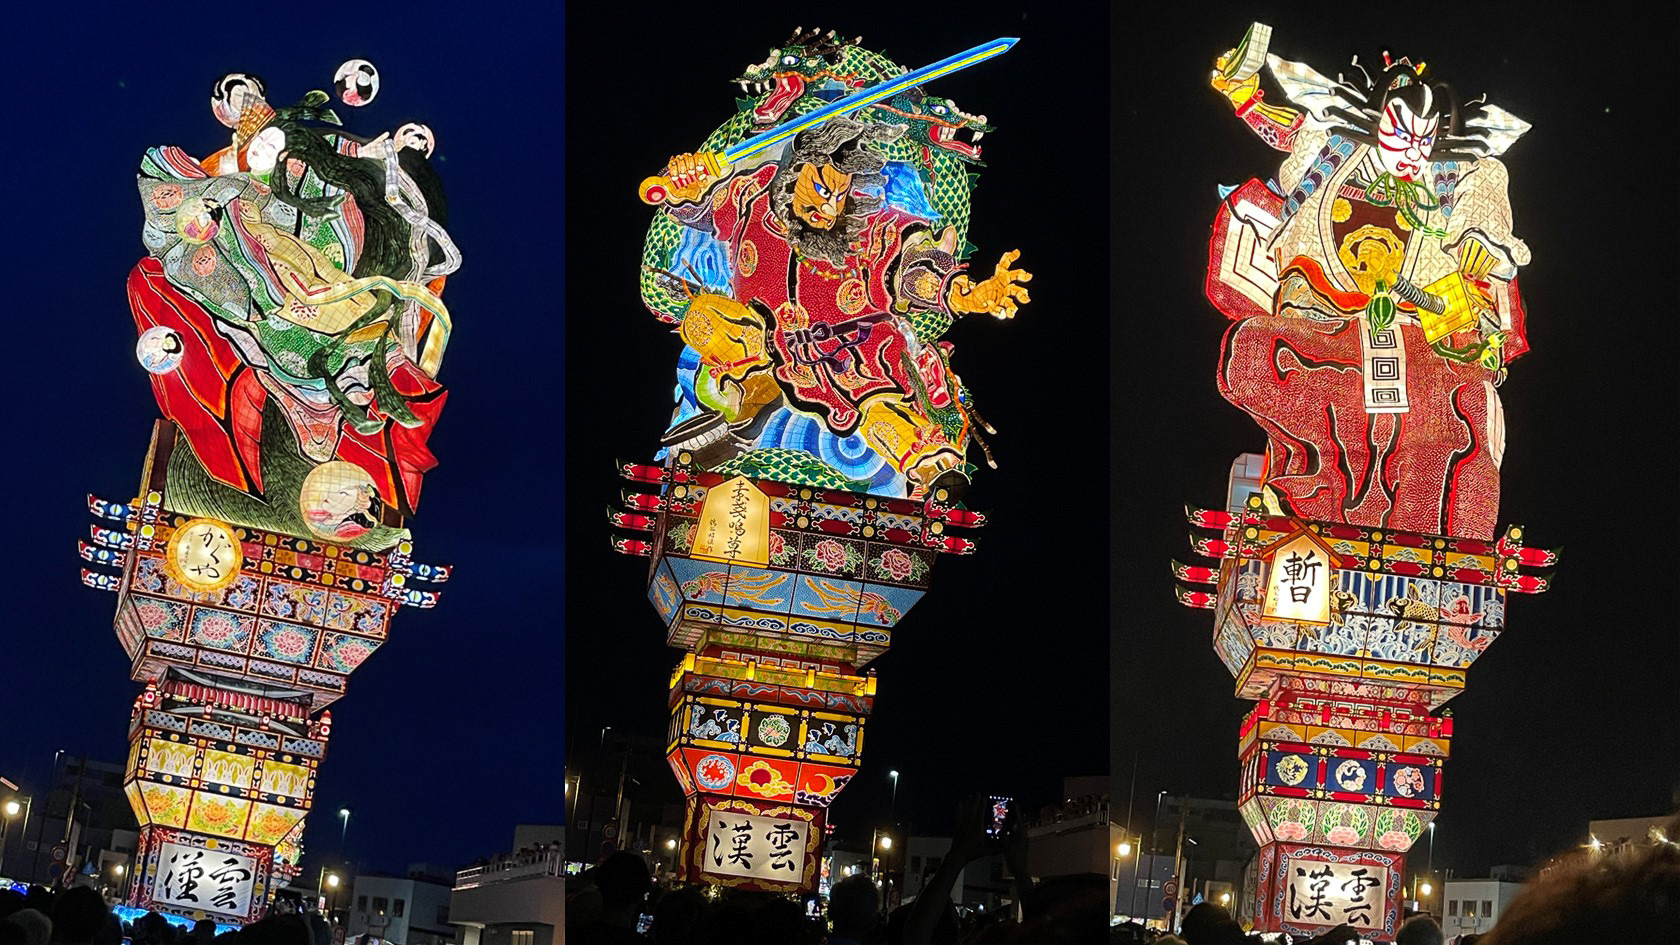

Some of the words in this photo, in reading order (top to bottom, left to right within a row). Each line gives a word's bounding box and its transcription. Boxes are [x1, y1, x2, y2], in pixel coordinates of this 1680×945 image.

[190, 528, 231, 578] かぐや
[1281, 550, 1322, 604] 暫
[713, 820, 799, 872] 雲漢
[1290, 865, 1380, 926] 雲漢
